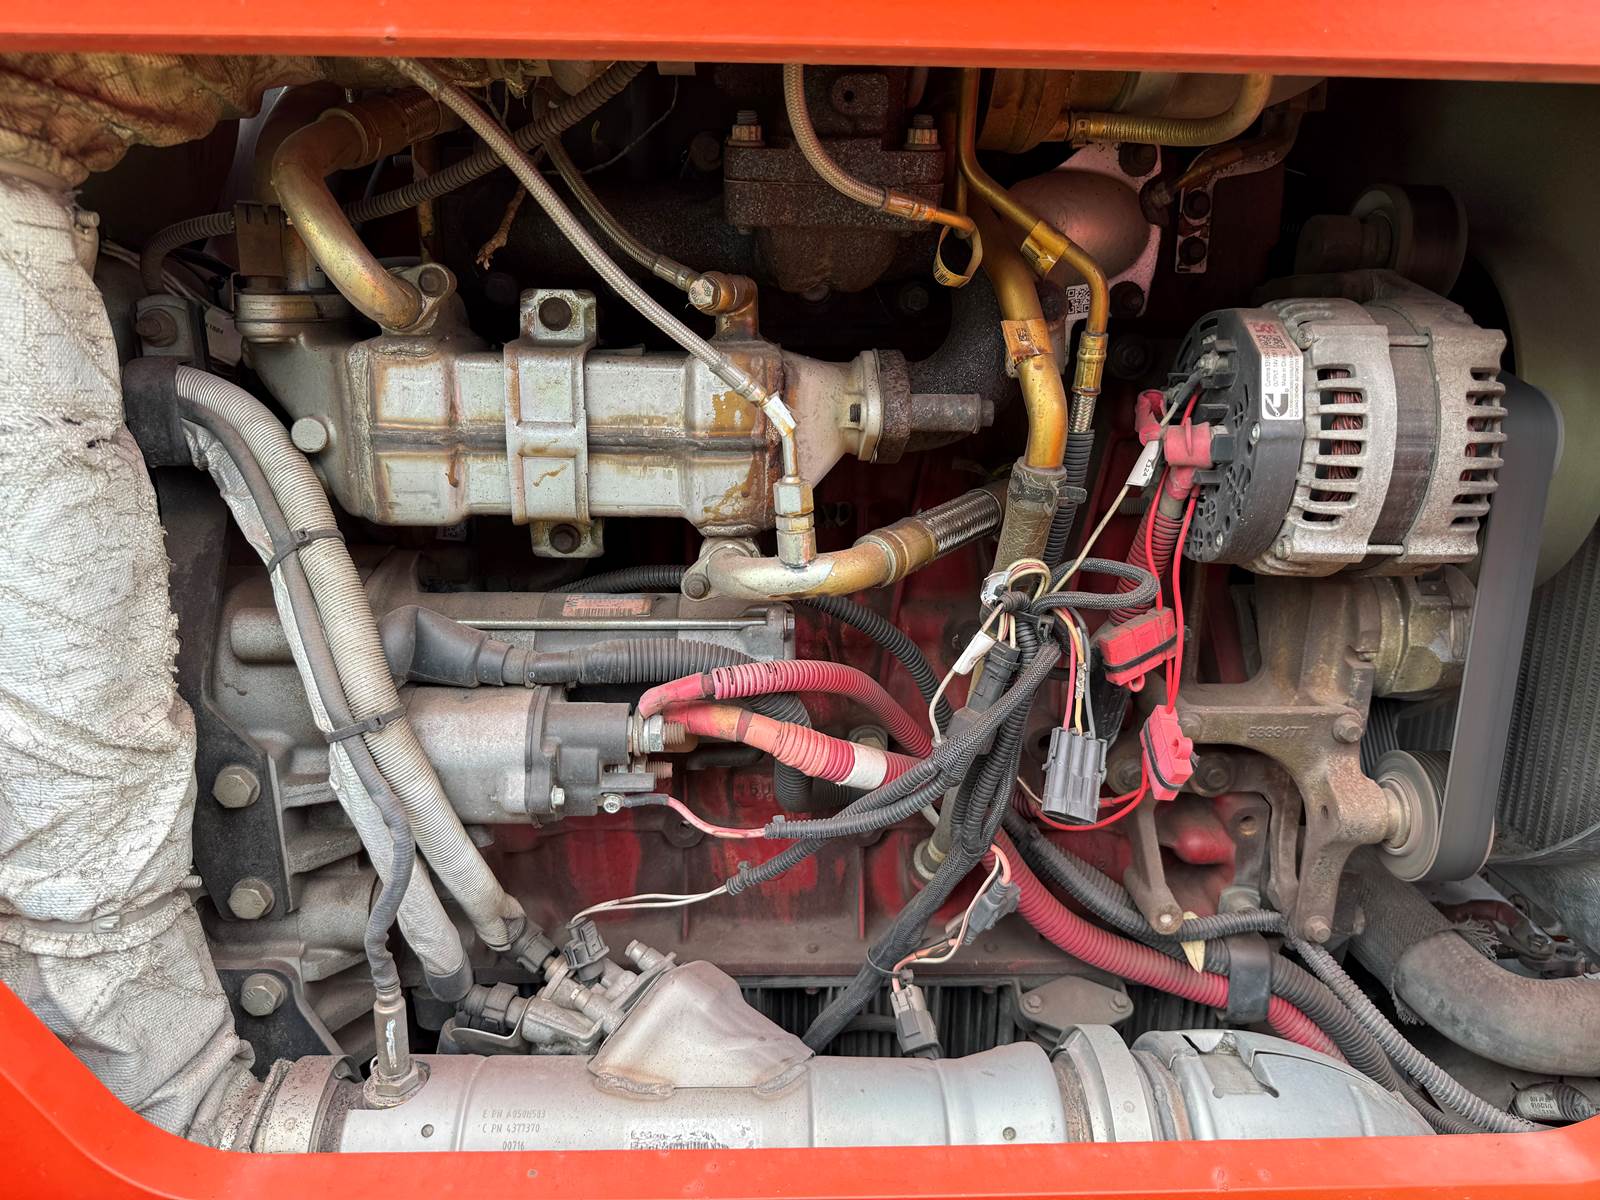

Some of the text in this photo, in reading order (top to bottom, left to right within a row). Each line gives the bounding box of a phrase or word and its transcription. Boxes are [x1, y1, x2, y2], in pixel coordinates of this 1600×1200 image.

[491, 1108, 503, 1119] PN
[482, 1122, 488, 1134] C
[491, 1122, 503, 1134] PN
